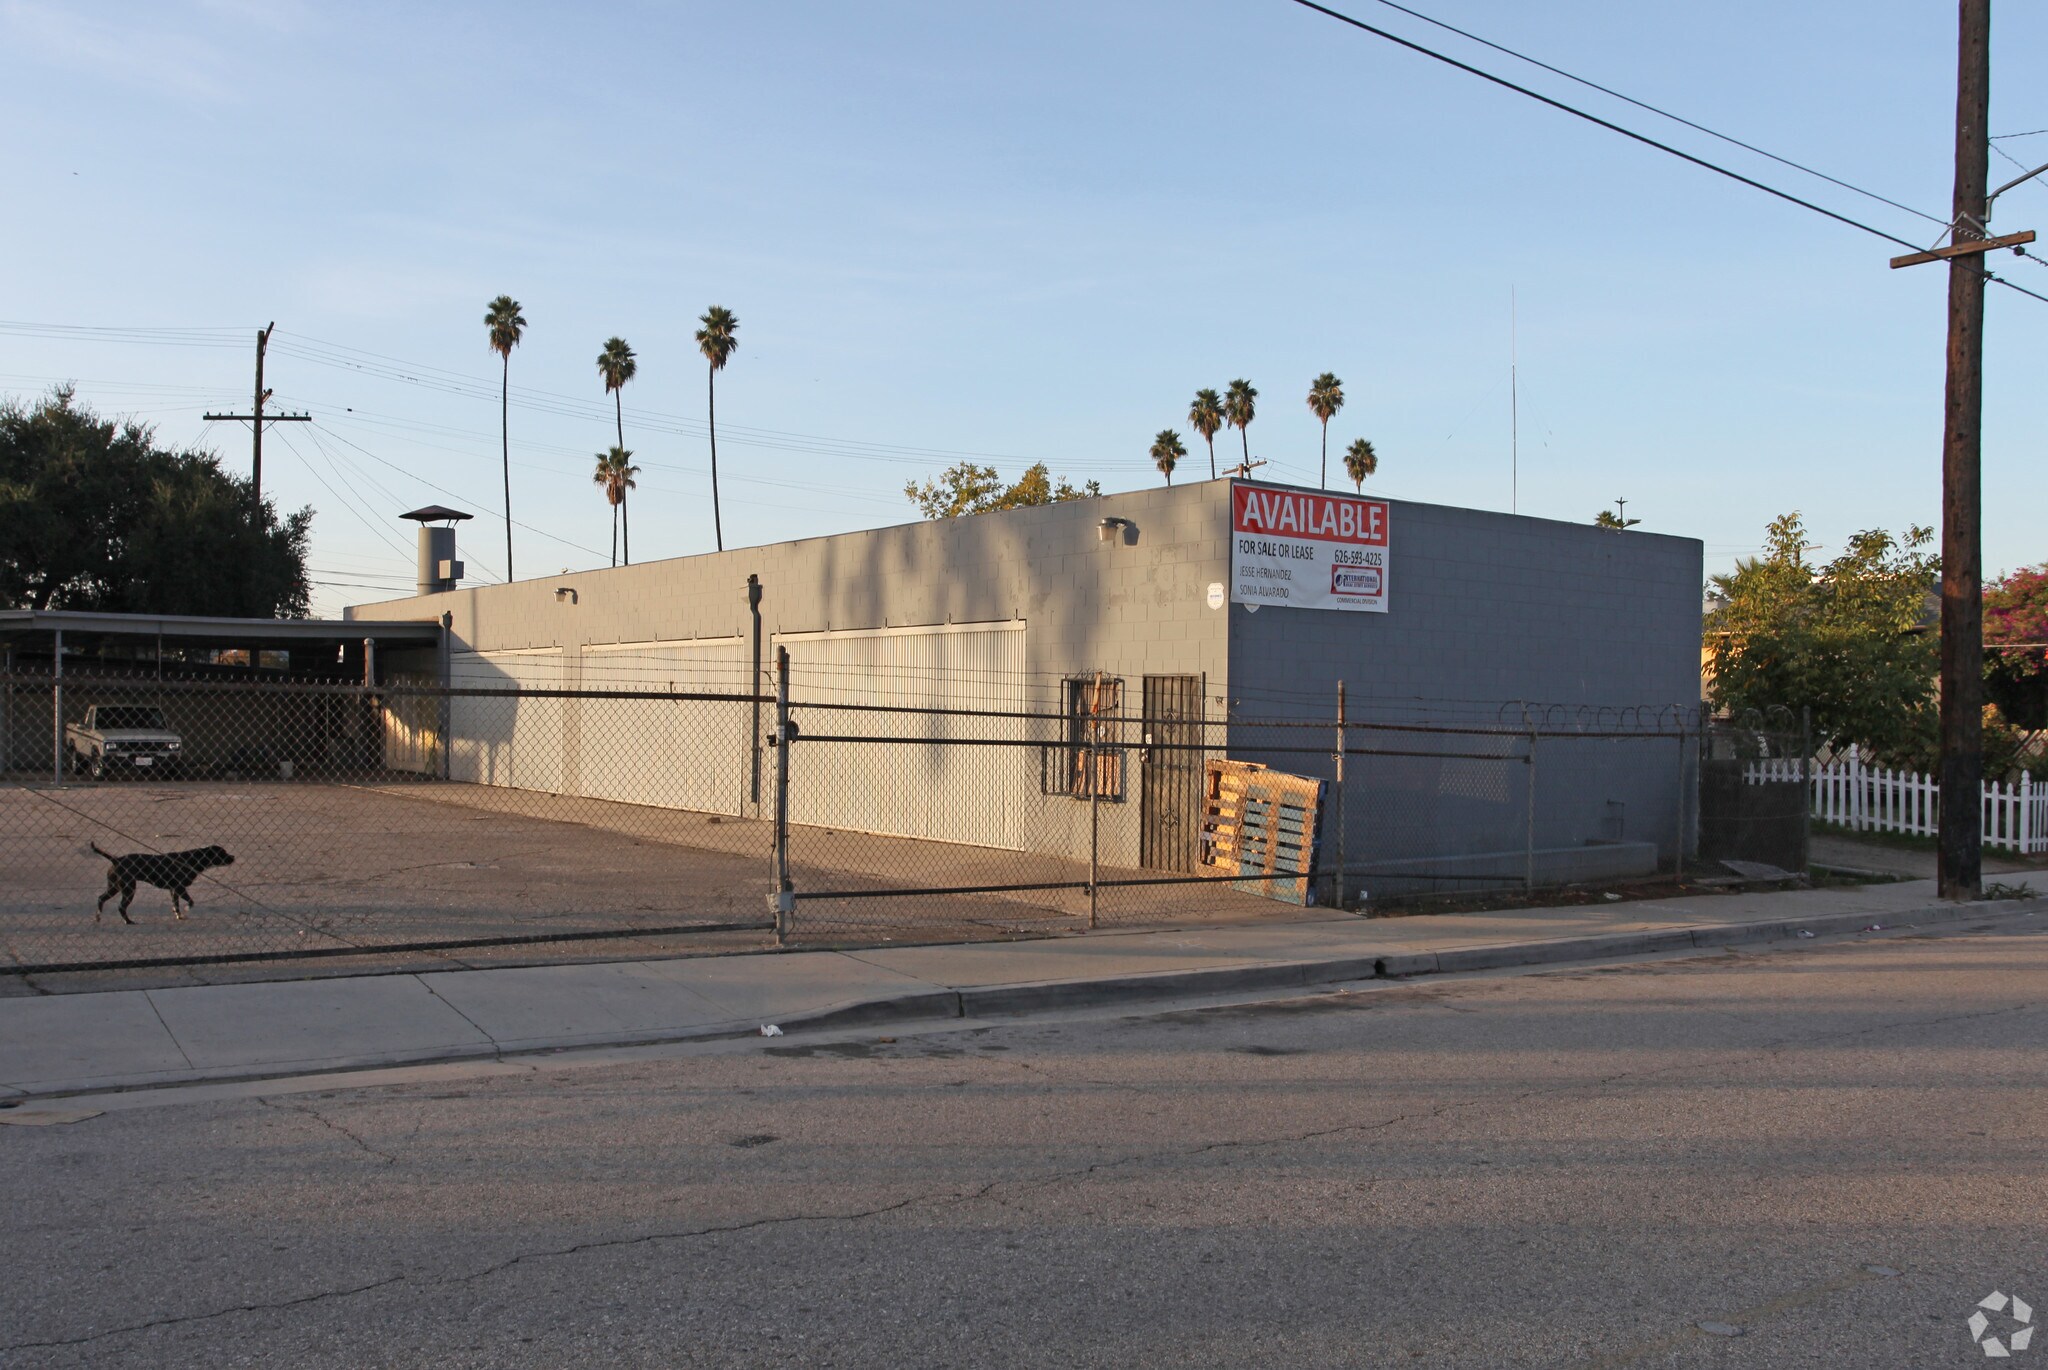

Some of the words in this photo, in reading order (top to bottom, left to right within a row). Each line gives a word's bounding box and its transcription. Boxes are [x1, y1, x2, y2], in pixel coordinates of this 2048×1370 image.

[1242, 491, 1382, 540] AVAILABLE
[1239, 539, 1255, 555] FOR
[1257, 541, 1277, 557] SALE
[1279, 544, 1290, 558] OR
[1291, 545, 1314, 560] LEASE
[1334, 549, 1382, 566] 626-593-4225
[1240, 566, 1255, 578] JESSE
[1256, 567, 1292, 581] HERNANDEZ
[1240, 584, 1257, 596] SONIA
[1259, 586, 1289, 598] ALVARADO
